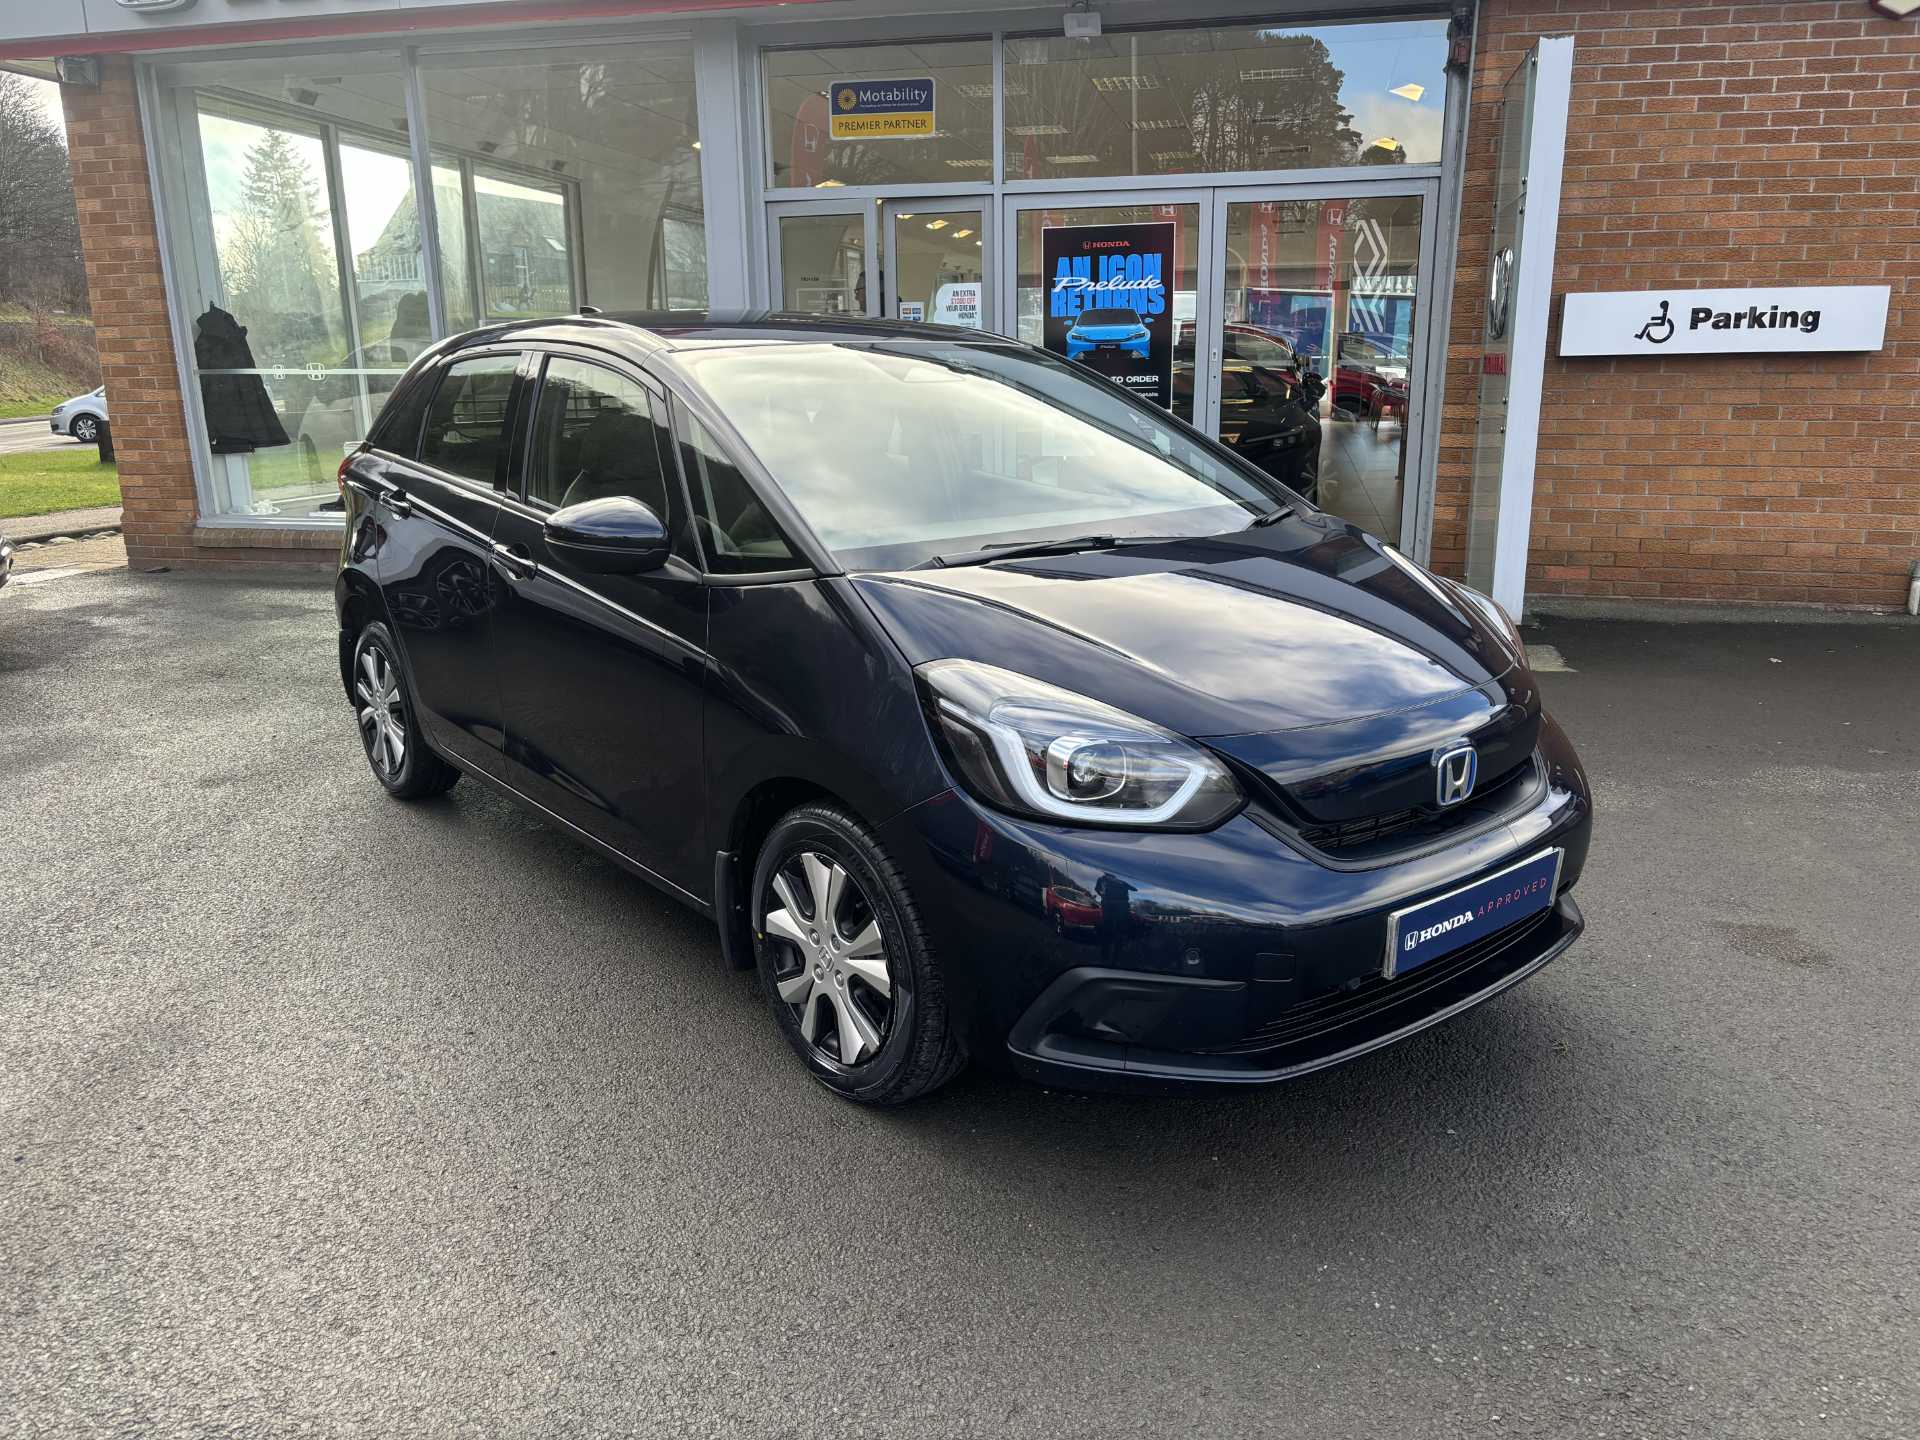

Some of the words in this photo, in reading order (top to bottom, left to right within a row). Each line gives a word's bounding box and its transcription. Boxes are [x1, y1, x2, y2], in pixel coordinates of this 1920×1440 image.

[860, 87, 927, 103] Motability
[839, 121, 880, 131] PREMIER
[883, 120, 927, 129] PARTNER
[1053, 275, 1162, 292] Prelude
[1055, 256, 1091, 286] AN
[1099, 253, 1162, 282] ICON
[1051, 286, 1165, 317] RETURNS
[1690, 305, 1821, 333] Parking
[1420, 911, 1474, 942] HONDA
[1477, 878, 1547, 918] APPROVED
